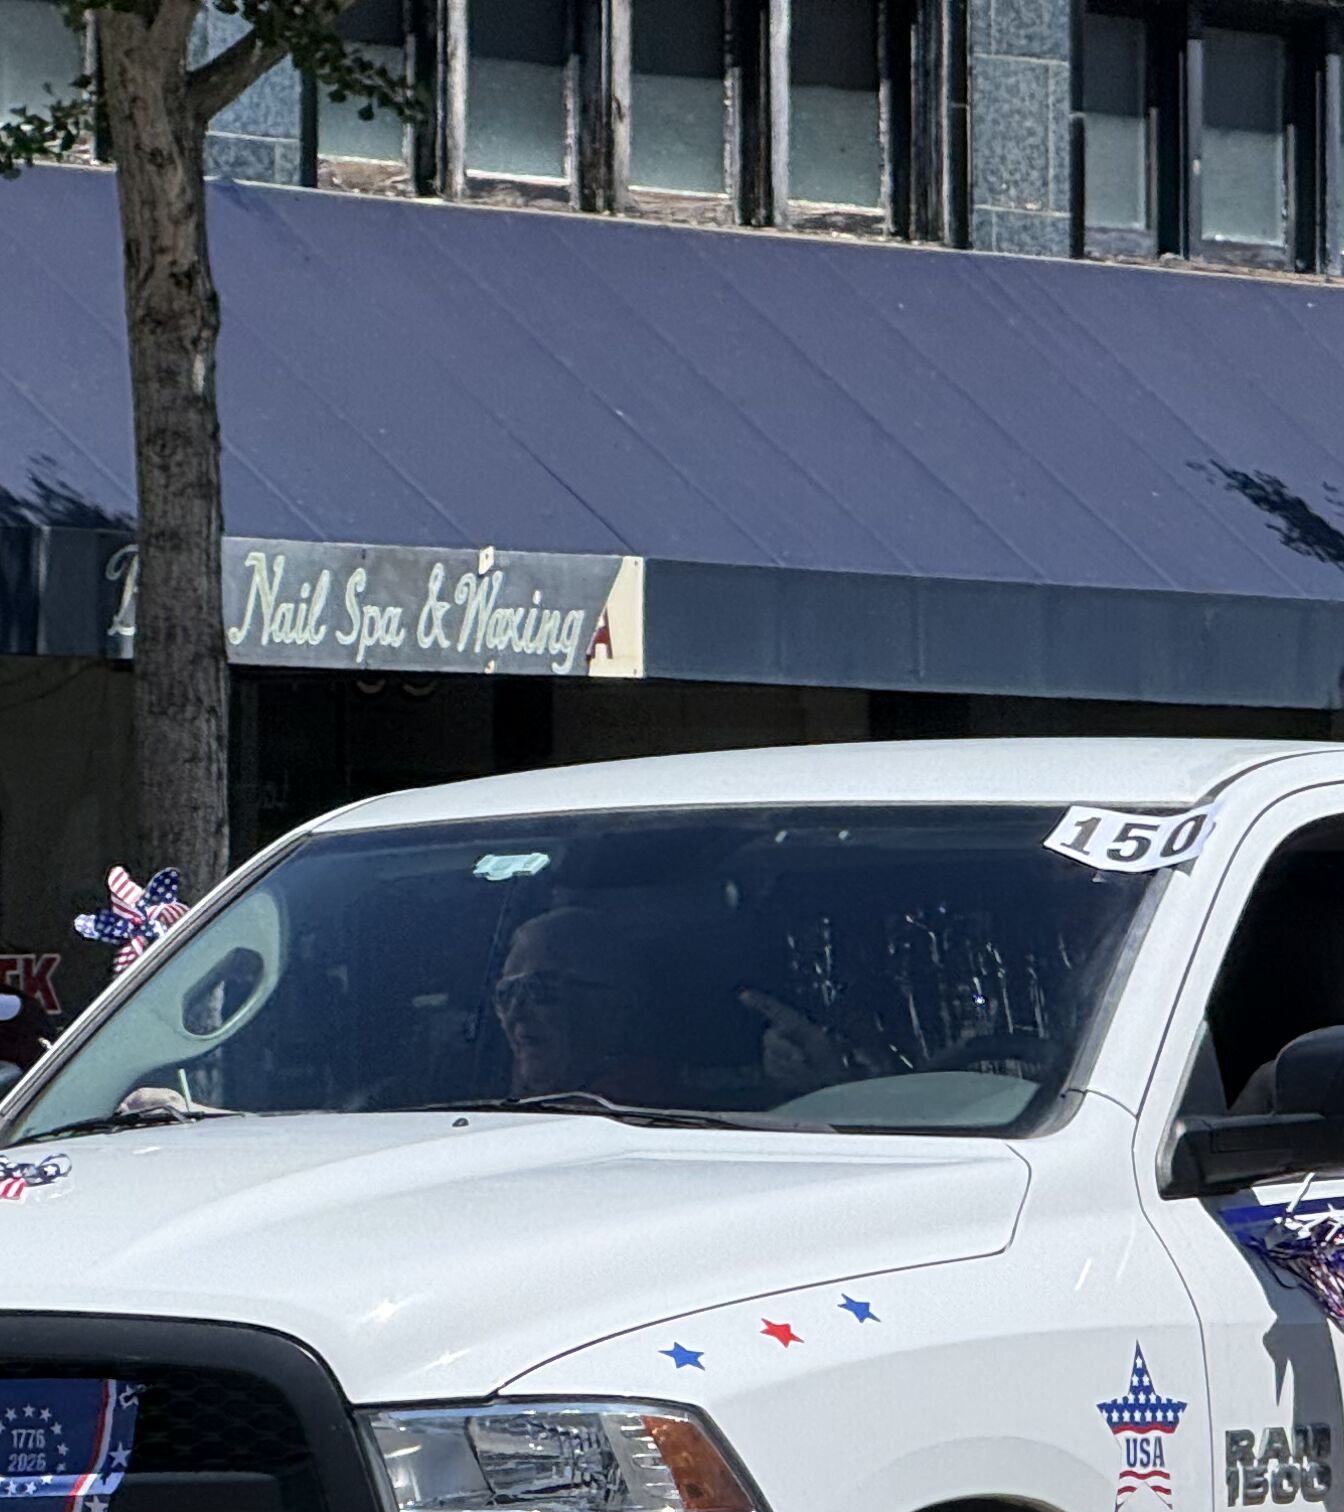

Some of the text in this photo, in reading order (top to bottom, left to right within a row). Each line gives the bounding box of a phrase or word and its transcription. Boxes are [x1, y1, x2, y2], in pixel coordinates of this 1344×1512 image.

[229, 552, 330, 645] Nail
[336, 567, 406, 663] Spa
[416, 563, 452, 649] &
[455, 570, 586, 675] Waxing
[1060, 814, 1209, 863] 150
[10, 1429, 47, 1449] 1776
[1125, 1436, 1166, 1468] USA
[1225, 1422, 1332, 1467] RAM
[8, 1453, 47, 1471] 2026
[1226, 1461, 1332, 1508] 1500
